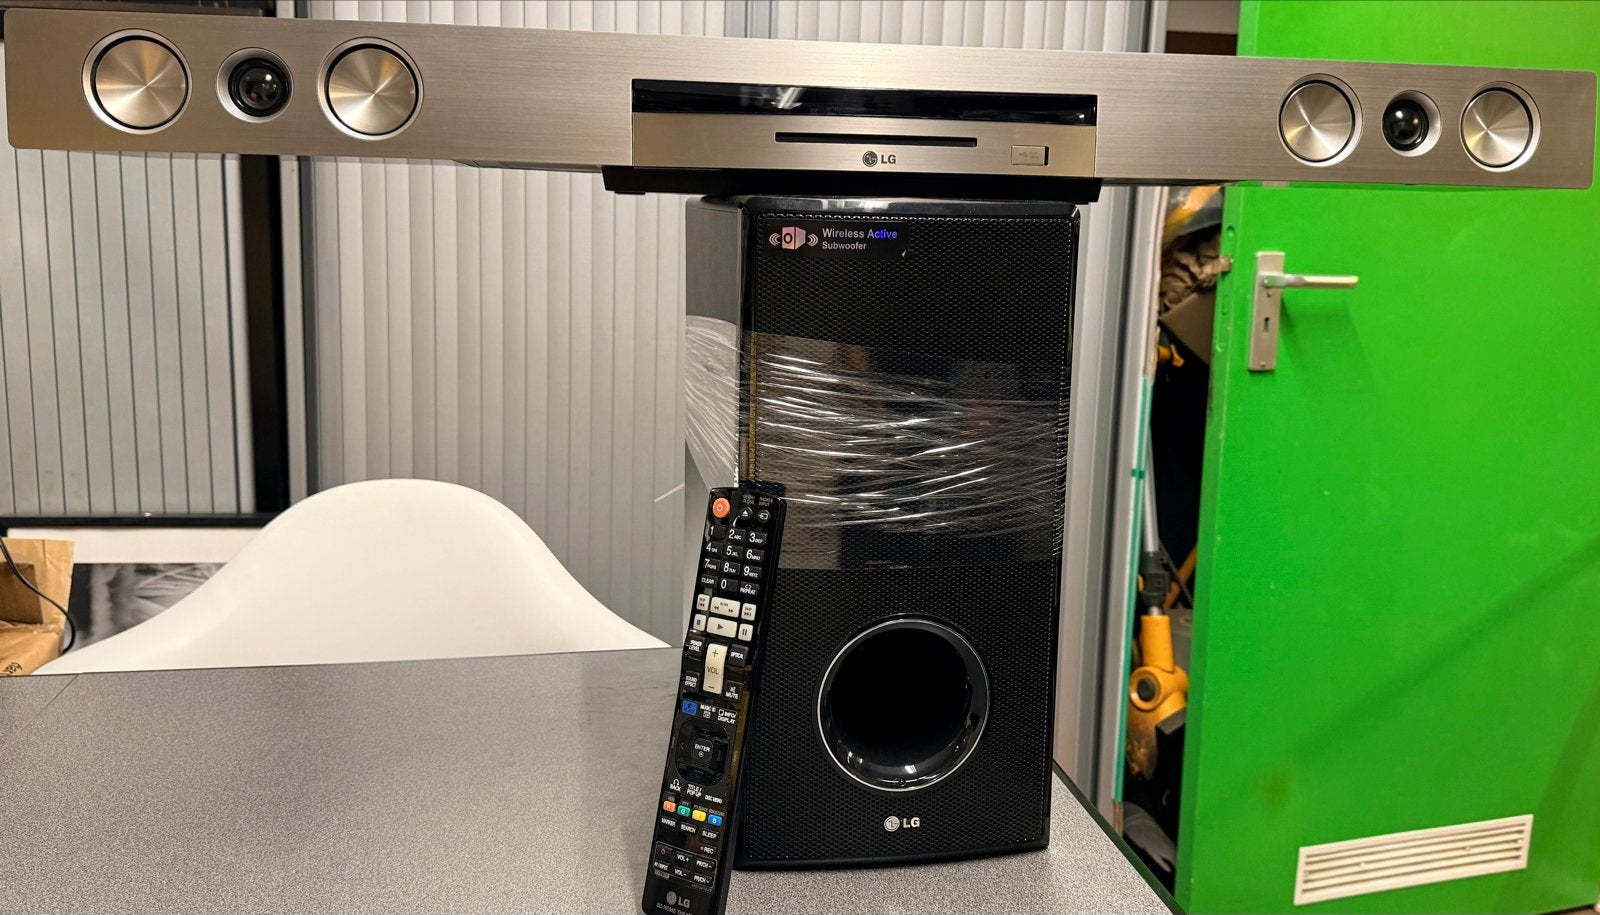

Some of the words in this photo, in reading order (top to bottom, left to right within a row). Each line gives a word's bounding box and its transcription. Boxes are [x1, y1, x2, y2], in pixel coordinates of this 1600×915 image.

[880, 154, 897, 165] LG
[822, 228, 865, 238] Wireless
[867, 229, 898, 239] Active
[822, 241, 867, 250] Subwoofer
[710, 525, 715, 535] 1
[701, 577, 715, 585] CLEAR
[740, 587, 756, 595] REPEAT
[706, 666, 720, 675] VOL
[725, 691, 739, 700] MUTE
[694, 743, 711, 753] ENTER
[669, 783, 681, 792] BACK
[903, 816, 921, 829] LG
[702, 830, 717, 839] SLEEP
[703, 846, 714, 855] REC
[677, 896, 691, 908] LG
